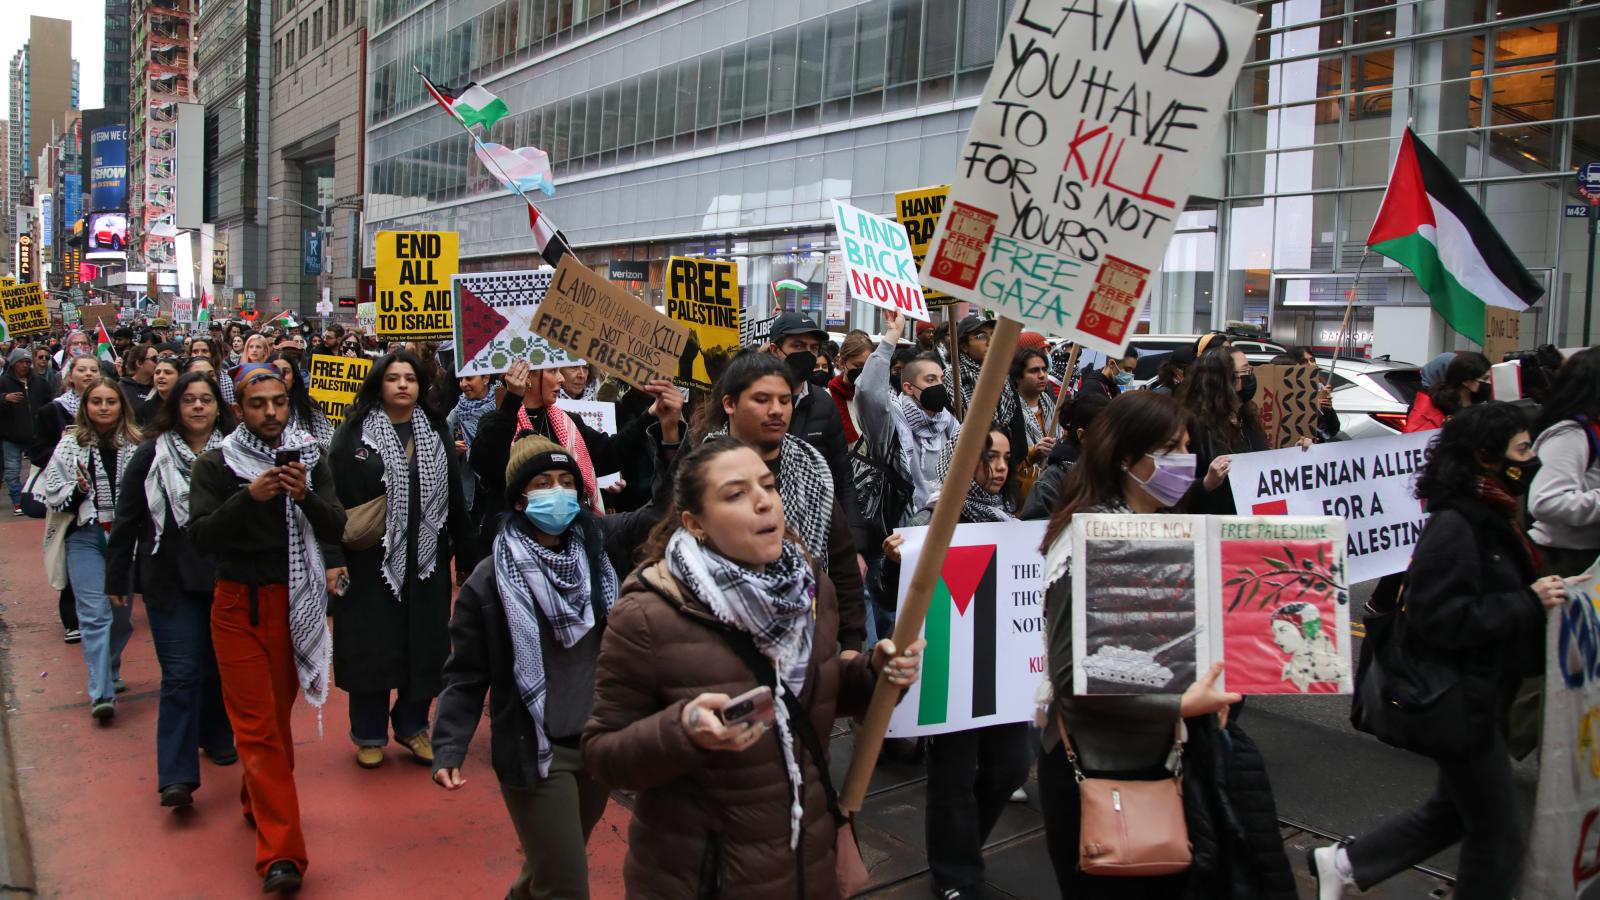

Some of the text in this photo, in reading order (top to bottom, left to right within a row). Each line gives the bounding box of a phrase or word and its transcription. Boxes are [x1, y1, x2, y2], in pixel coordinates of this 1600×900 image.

[1016, 0, 1229, 78] LAND
[999, 33, 1208, 153] YOU HAVE
[110, 130, 121, 141] WE
[992, 101, 1177, 209] TO KILL
[963, 141, 1171, 240] FOR IS NOT
[1566, 206, 1586, 216] M42
[837, 205, 907, 251] LAND
[903, 216, 940, 245] RA
[947, 230, 985, 251] FREE
[1009, 191, 1108, 263] YOURS
[21, 246, 30, 274] REGAL
[396, 233, 441, 259] END
[844, 236, 916, 284] BACK
[399, 260, 439, 285] ALL
[611, 269, 643, 279] verizon
[989, 235, 1081, 293] FREE
[1, 285, 40, 298] HANDS OFF
[670, 258, 732, 307] FREE
[851, 268, 924, 316] NOW!
[1097, 284, 1135, 306] FREE
[4, 293, 42, 311] RAFAH!
[380, 290, 419, 313] U.S.
[423, 290, 452, 312] AID
[979, 268, 1072, 327] GAZA
[8, 318, 48, 332] GENOCIDE!
[9, 309, 44, 323] STOP THE
[379, 314, 398, 331] TO
[556, 267, 597, 308] LAND
[595, 291, 617, 319] YOU
[613, 305, 641, 334] HAVE
[649, 319, 683, 359] KILL
[667, 299, 739, 329] PALESTINE
[536, 312, 582, 351] FREE
[554, 296, 661, 367] FOR IS NOT YOURS
[312, 360, 345, 379] FREE
[1256, 456, 1366, 498] ARMENIAN
[1322, 491, 1384, 520] FOR A
[1086, 520, 1193, 539] CEASEFIRE NOW
[1220, 522, 1328, 539] FREE PALESTINE
[1011, 563, 1041, 580] THE
